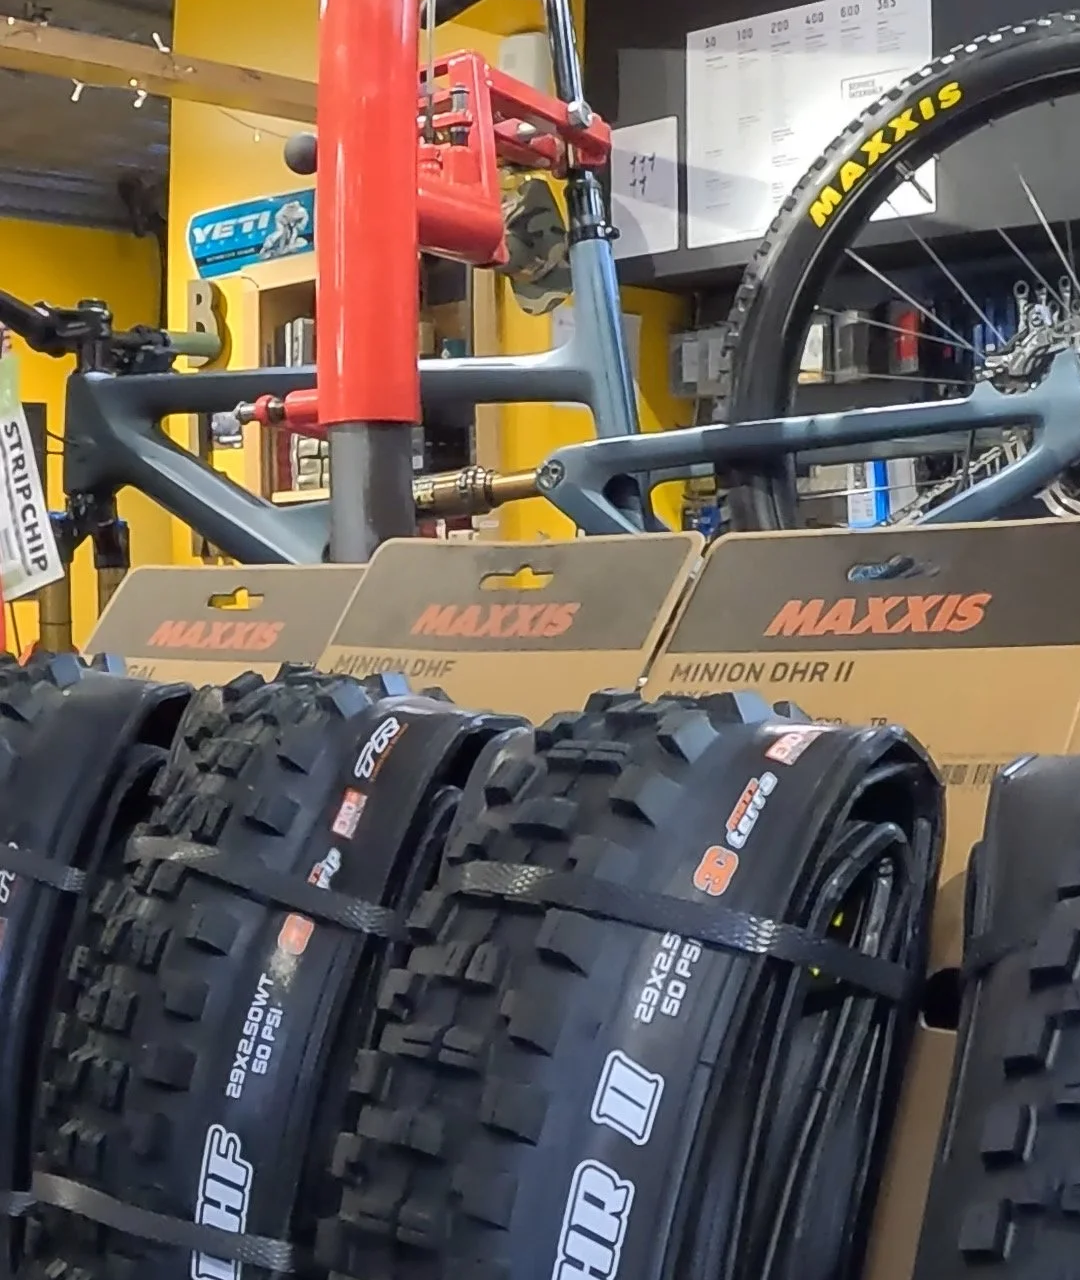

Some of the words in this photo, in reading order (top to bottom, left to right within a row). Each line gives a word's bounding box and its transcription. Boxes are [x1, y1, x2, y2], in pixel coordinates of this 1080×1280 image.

[736, 27, 753, 41] 100
[770, 19, 790, 34] 200
[808, 81, 965, 230] MAXXIS
[192, 211, 272, 244] YETI
[3, 420, 49, 573] STRIPCHIP
[410, 602, 581, 638] MAXXIS
[763, 592, 992, 637] MAXXIS
[147, 621, 286, 650] MAXXIS
[410, 659, 457, 678] DHF
[668, 662, 763, 684] MINION
[768, 662, 827, 683] DHR
[635, 931, 682, 1023] 29X2.5
